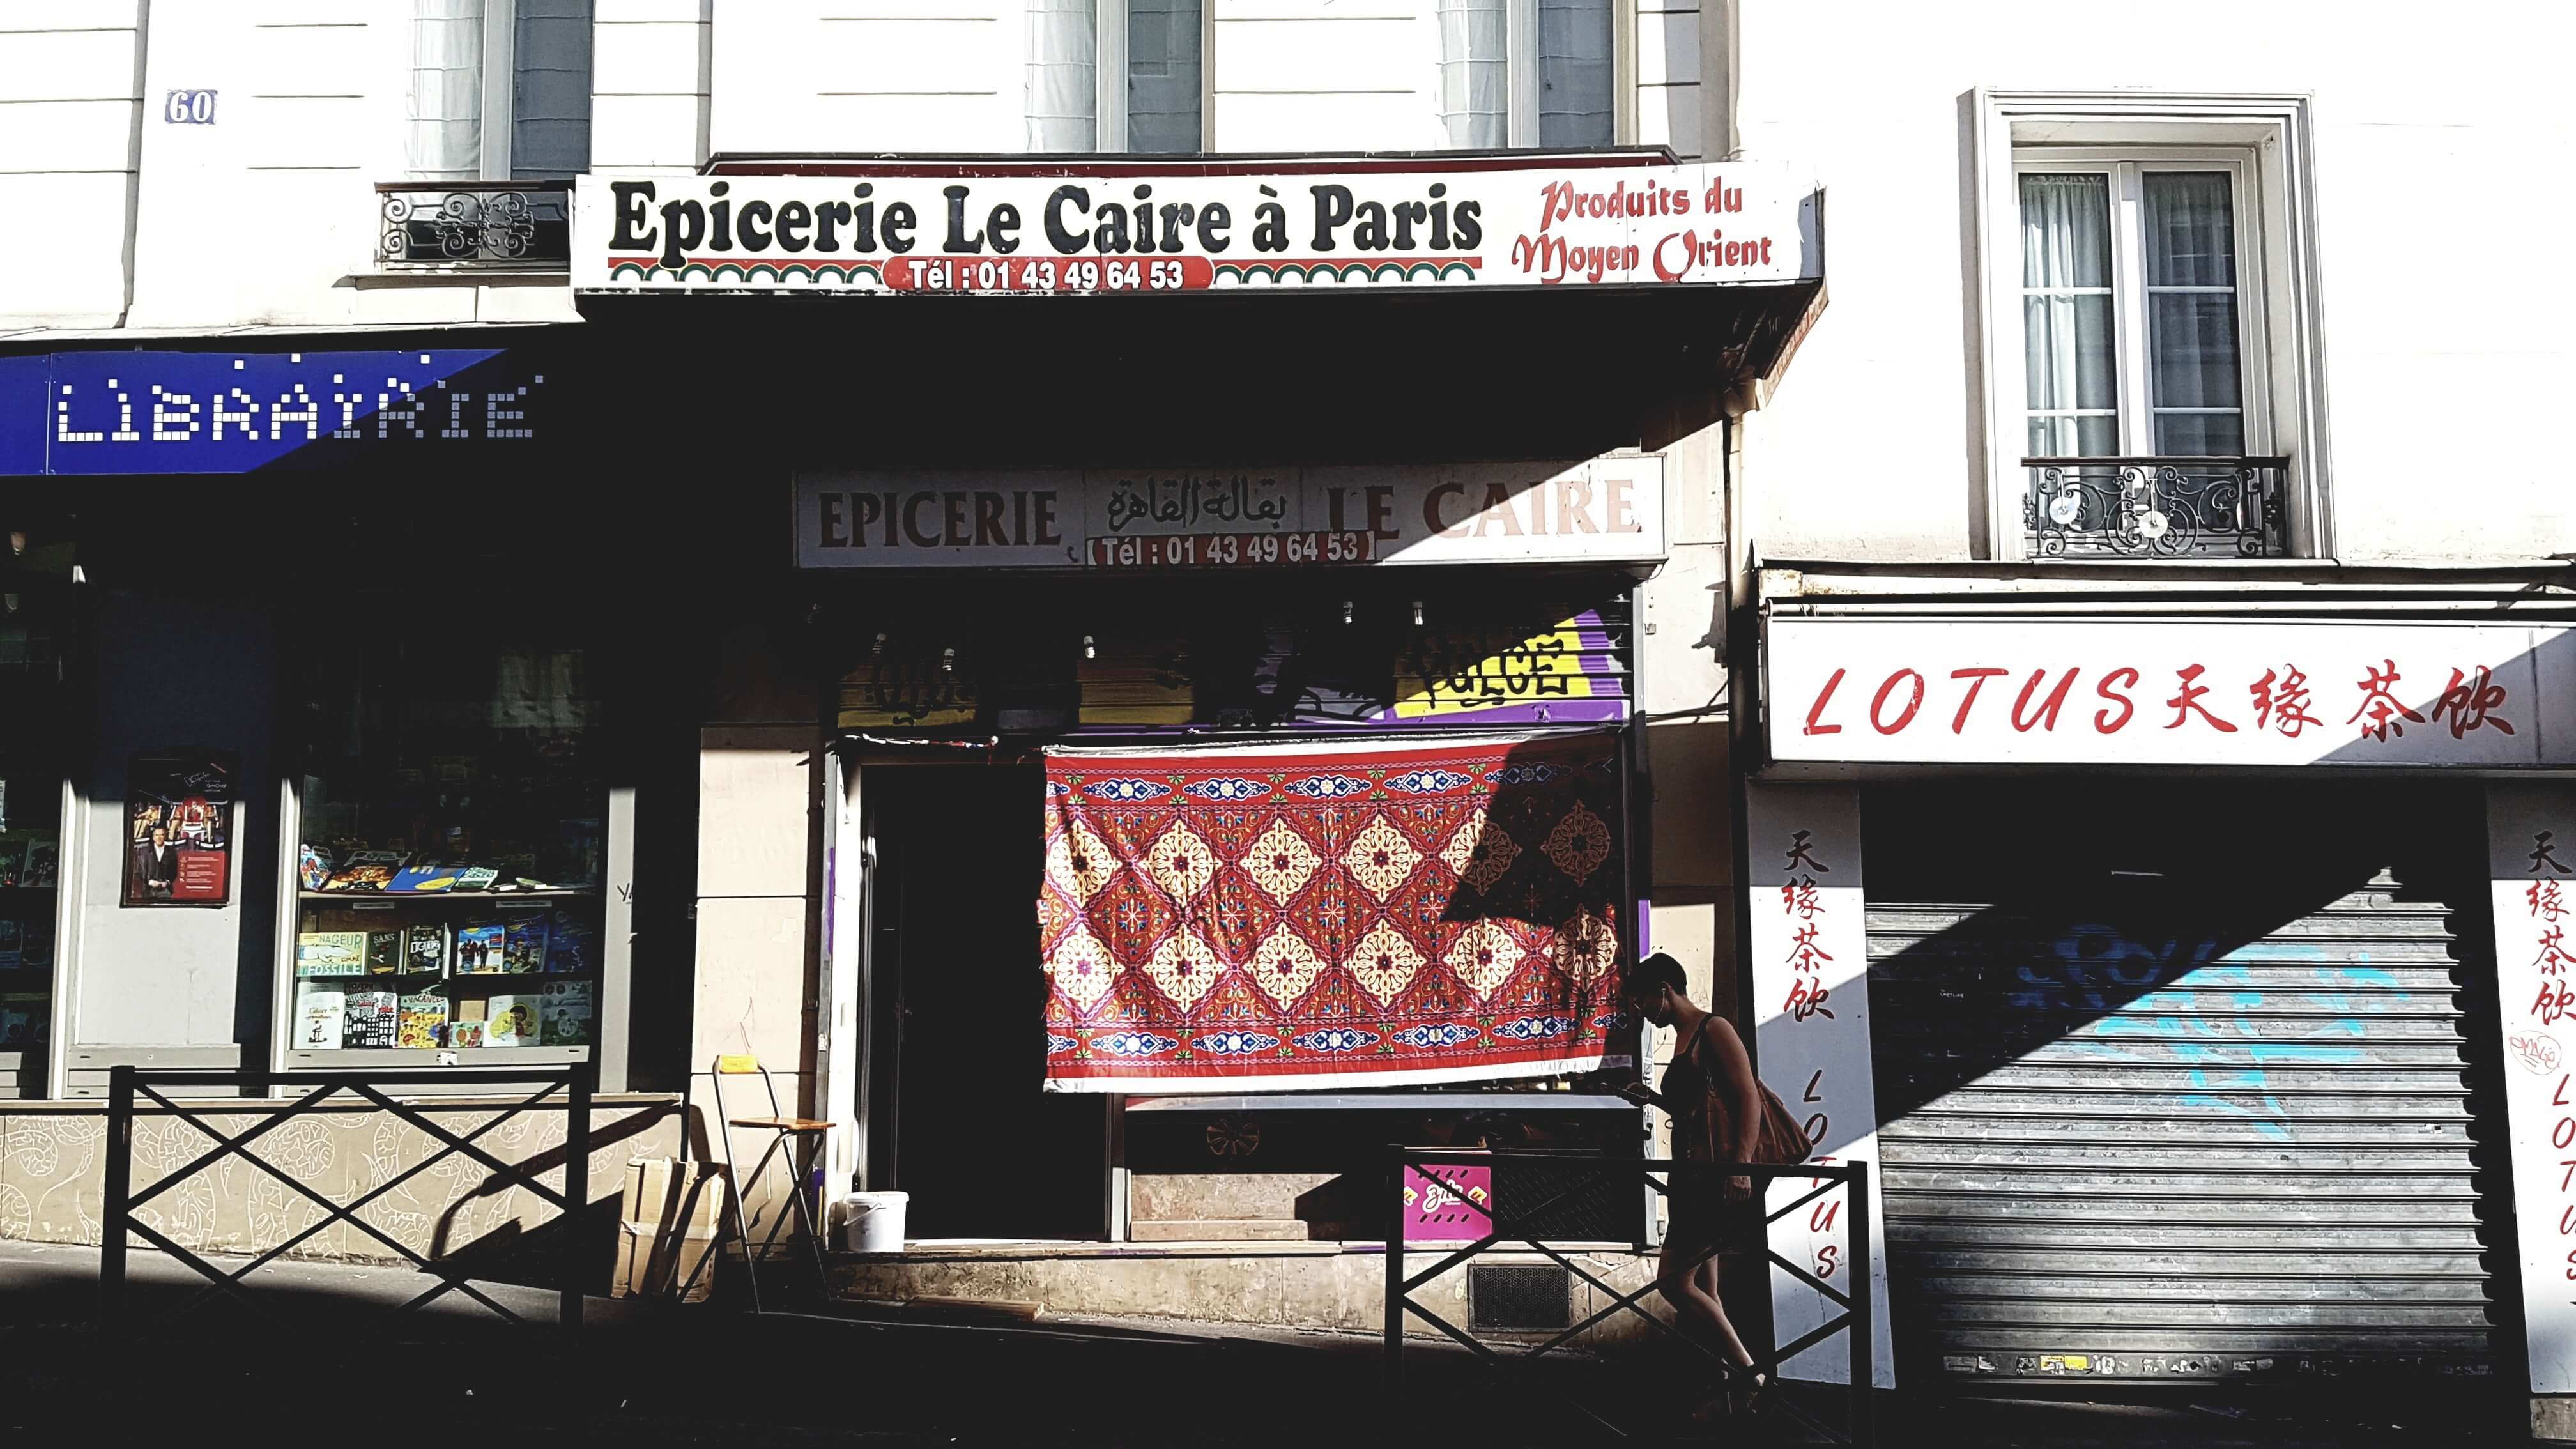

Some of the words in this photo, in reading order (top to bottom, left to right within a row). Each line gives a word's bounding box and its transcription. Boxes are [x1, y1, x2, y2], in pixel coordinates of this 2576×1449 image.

[169, 91, 214, 123] 60
[609, 180, 917, 268] Epicerie
[942, 185, 1021, 255] Le
[1044, 183, 1231, 255] Caire
[1252, 183, 1289, 253] à
[1310, 182, 1482, 252] Paris
[1540, 178, 1690, 233] Produits
[1705, 176, 1743, 215] du
[984, 261, 1011, 289] 01
[1022, 261, 1056, 289] 43
[1064, 261, 1099, 289] 49
[1107, 261, 1141, 289] 64
[1149, 261, 1184, 289] 53
[1512, 232, 1639, 284] Moyen
[1652, 229, 1772, 282] Orient
[57, 367, 544, 443] LIBRAIRIE
[818, 491, 1062, 548] EPICERIE
[1107, 471, 1201, 532] القاهرة
[1202, 475, 1287, 530] بقالة
[1326, 485, 1401, 540] LE
[1422, 479, 1643, 539] CAIRE
[1167, 537, 1195, 565] 01
[1206, 535, 1238, 564] 43
[1246, 535, 1278, 564] 49
[1287, 533, 1318, 563] 64
[1326, 532, 1358, 562] 53
[1802, 666, 2140, 736] LOTUS
[2163, 658, 2515, 743] 天缘茶饮
[319, 933, 363, 949] NAGEUR
[1781, 829, 1835, 1023] 天缘茶饮
[2526, 831, 2576, 1025] 天缘茶饮
[307, 963, 361, 975] FOSSILE
[1803, 1068, 1841, 1279] LOTUS
